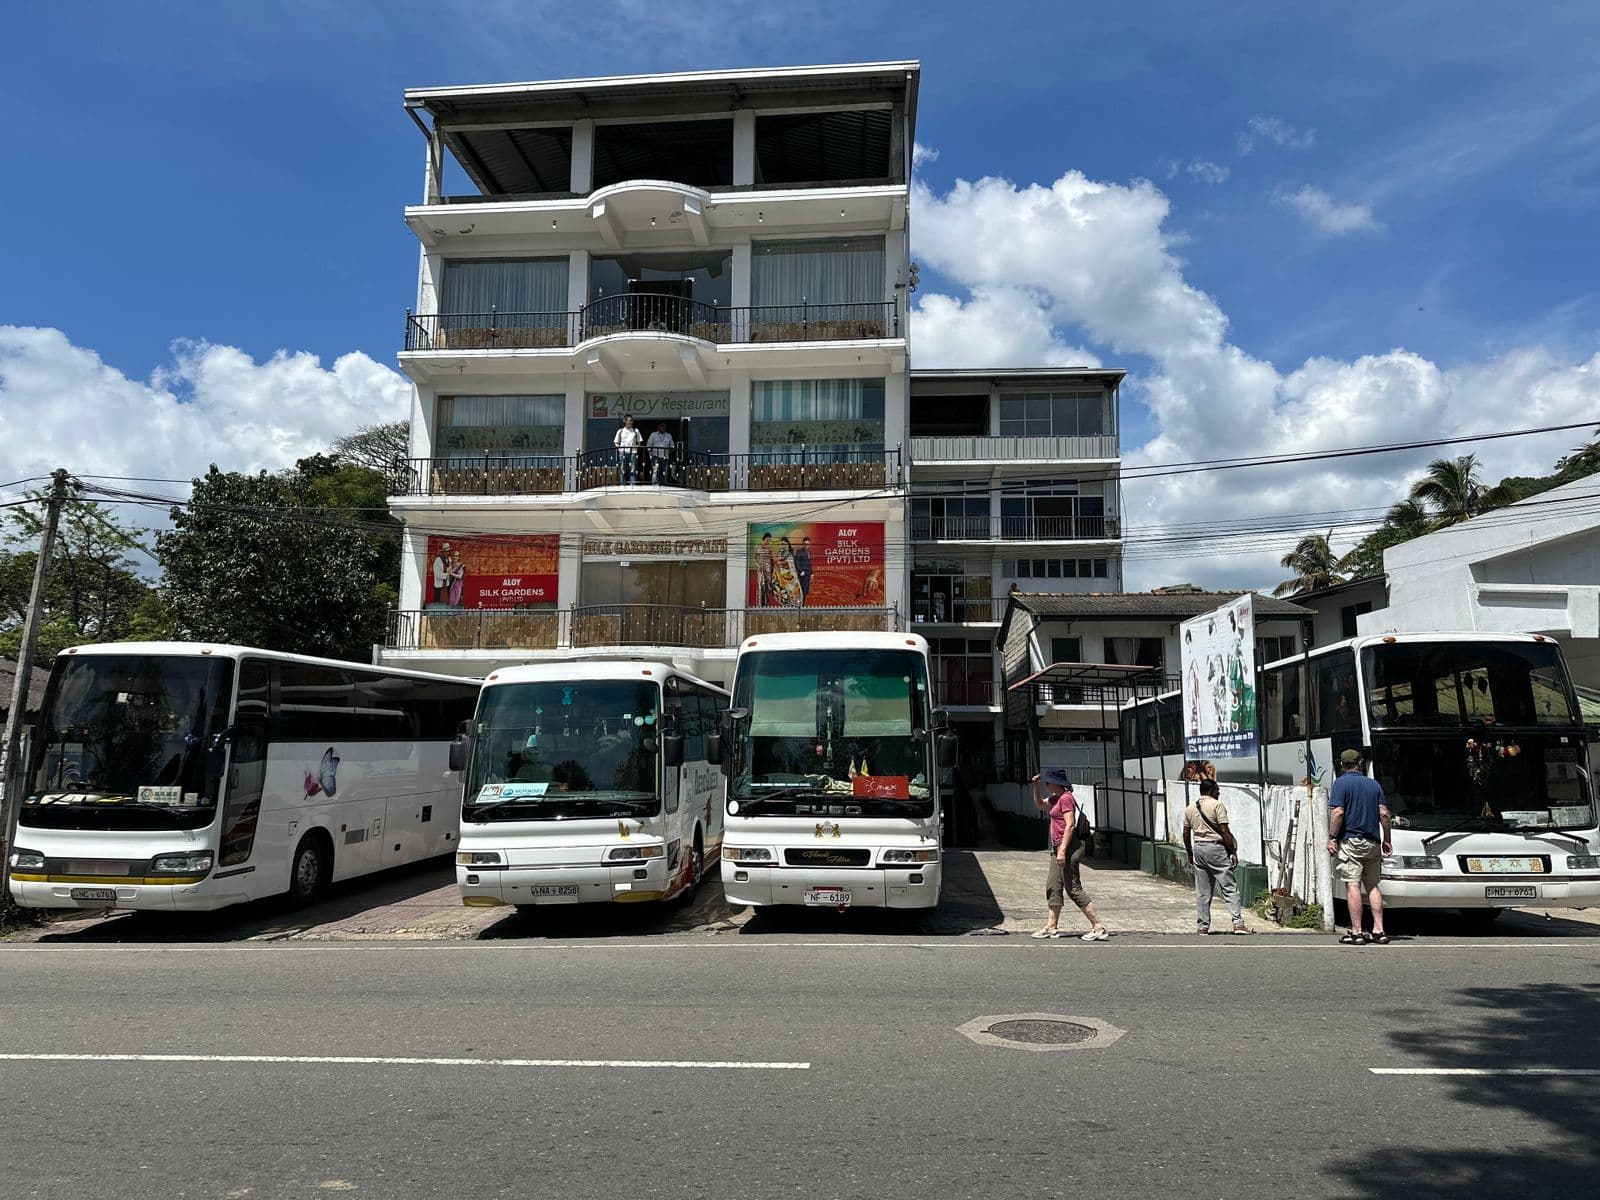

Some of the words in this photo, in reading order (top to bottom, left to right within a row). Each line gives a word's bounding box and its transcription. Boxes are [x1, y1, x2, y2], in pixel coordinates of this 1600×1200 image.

[610, 394, 660, 415] Aloy
[662, 397, 727, 410] Restaurant
[837, 540, 858, 548] SILK
[826, 556, 851, 564] (PVT)
[480, 589, 499, 597] SILK
[501, 588, 544, 596] GARDENS
[796, 805, 862, 815] FUSO
